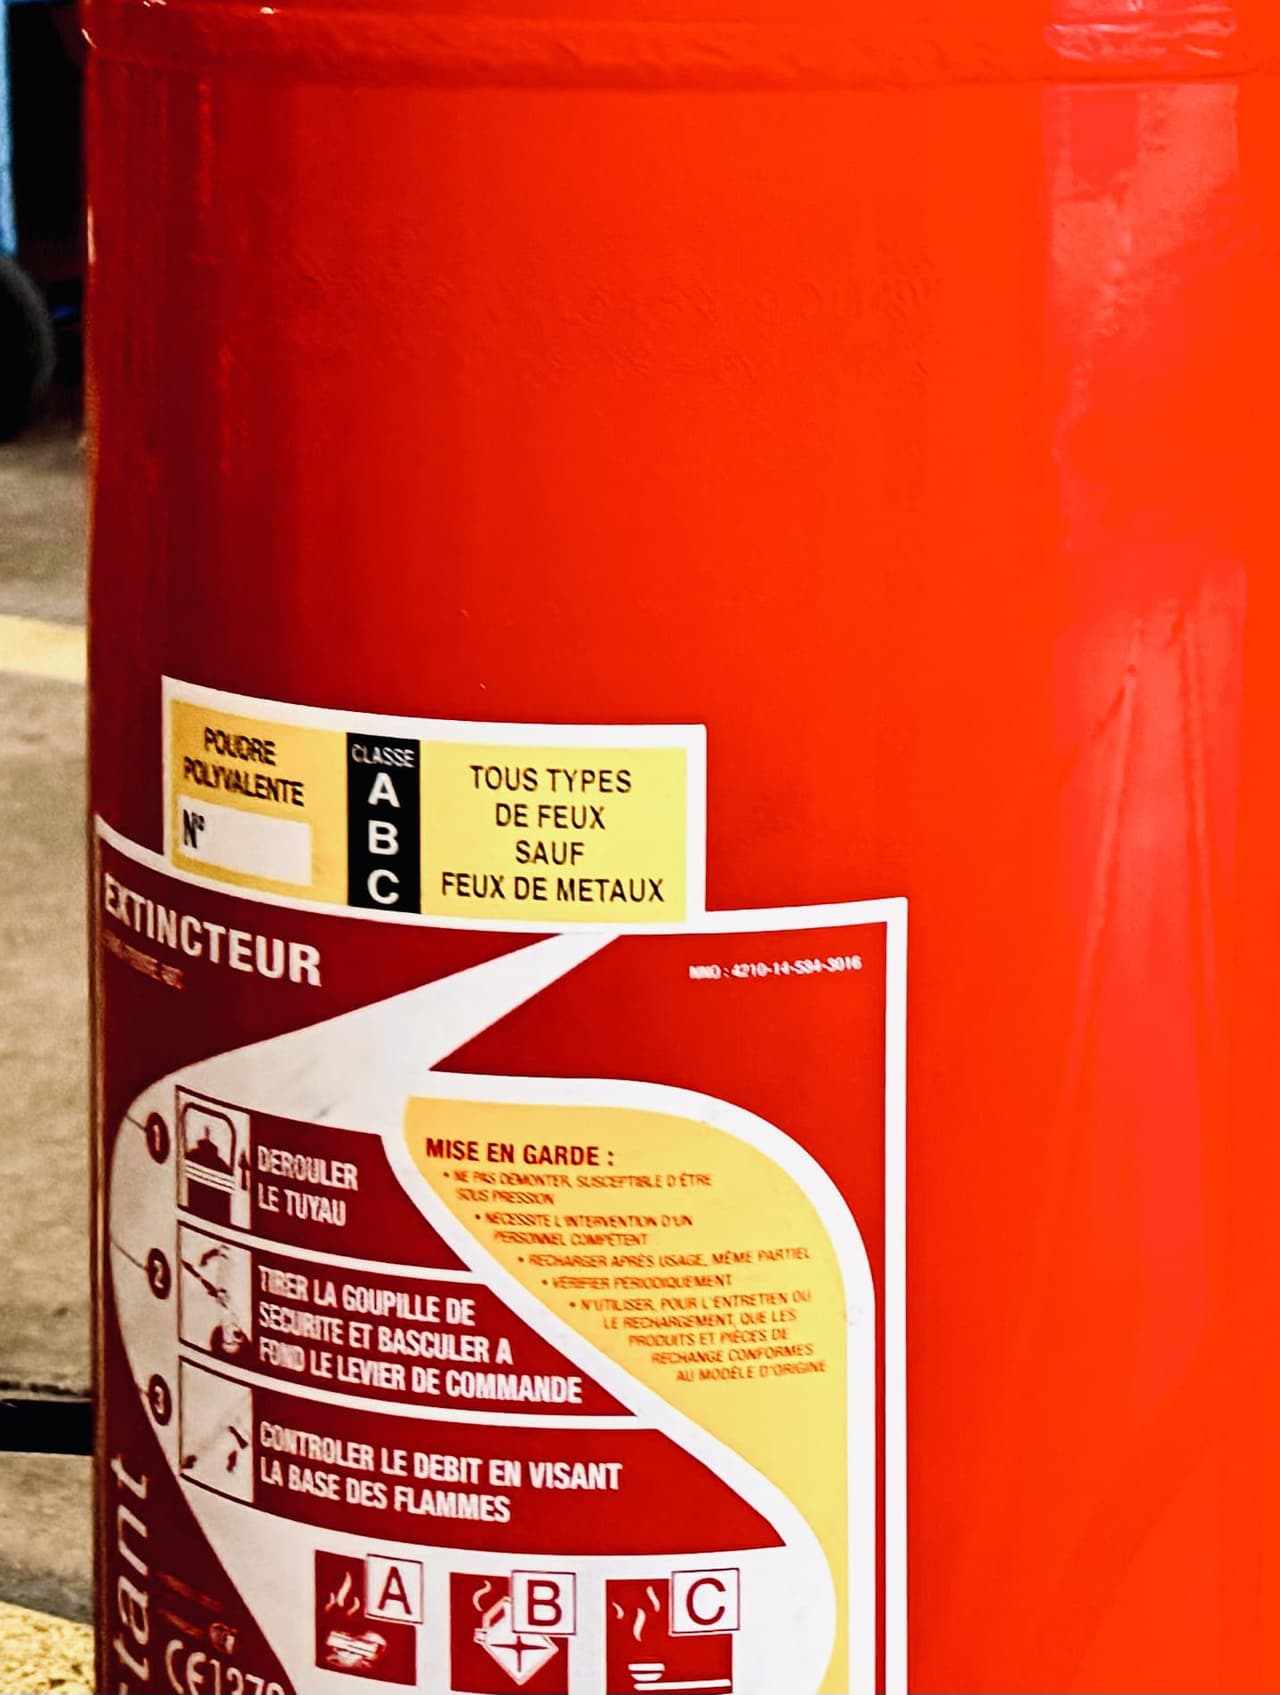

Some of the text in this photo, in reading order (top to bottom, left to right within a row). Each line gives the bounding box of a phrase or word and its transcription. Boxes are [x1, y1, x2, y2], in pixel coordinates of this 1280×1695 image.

[204, 727, 276, 766] POUDRE
[352, 744, 415, 768] CLASSE
[183, 756, 305, 807] POLYVALENTE
[368, 772, 400, 807] A
[470, 765, 632, 793] TOUS TYPES
[495, 803, 606, 830] DE FEUX
[368, 819, 399, 855] B
[515, 840, 584, 865] SAUF
[367, 869, 399, 904] C
[442, 871, 664, 902] FEUX DE METAUX
[104, 871, 322, 987] EXTINCTEUR
[257, 1145, 358, 1191] DEROULER
[425, 1137, 479, 1162] MISE
[486, 1142, 514, 1164] EN
[523, 1144, 600, 1166] GARDE
[257, 1182, 346, 1226] LE TUYAU
[258, 1264, 476, 1326] TIRER LA GOUPILLE DE
[259, 1301, 514, 1365] SECURITE ET BASCULER A
[602, 1317, 619, 1329] LE
[771, 1309, 797, 1323] LES
[628, 1334, 695, 1348] PRODUITS
[699, 1332, 715, 1346] ET
[772, 1327, 789, 1340] DE
[259, 1337, 582, 1404] FOND LE LEVIER DE COMMANDE
[651, 1344, 814, 1365] RECHANGE CONFORMES
[676, 1369, 695, 1383] AU
[260, 1420, 623, 1490] CONTROLER LE DEBIT EN VISANT
[260, 1456, 511, 1523] LA BASE DES FLAMMES
[110, 1453, 149, 1695] tant
[377, 1566, 413, 1615] A
[527, 1579, 563, 1627] B
[686, 1577, 727, 1626] C
